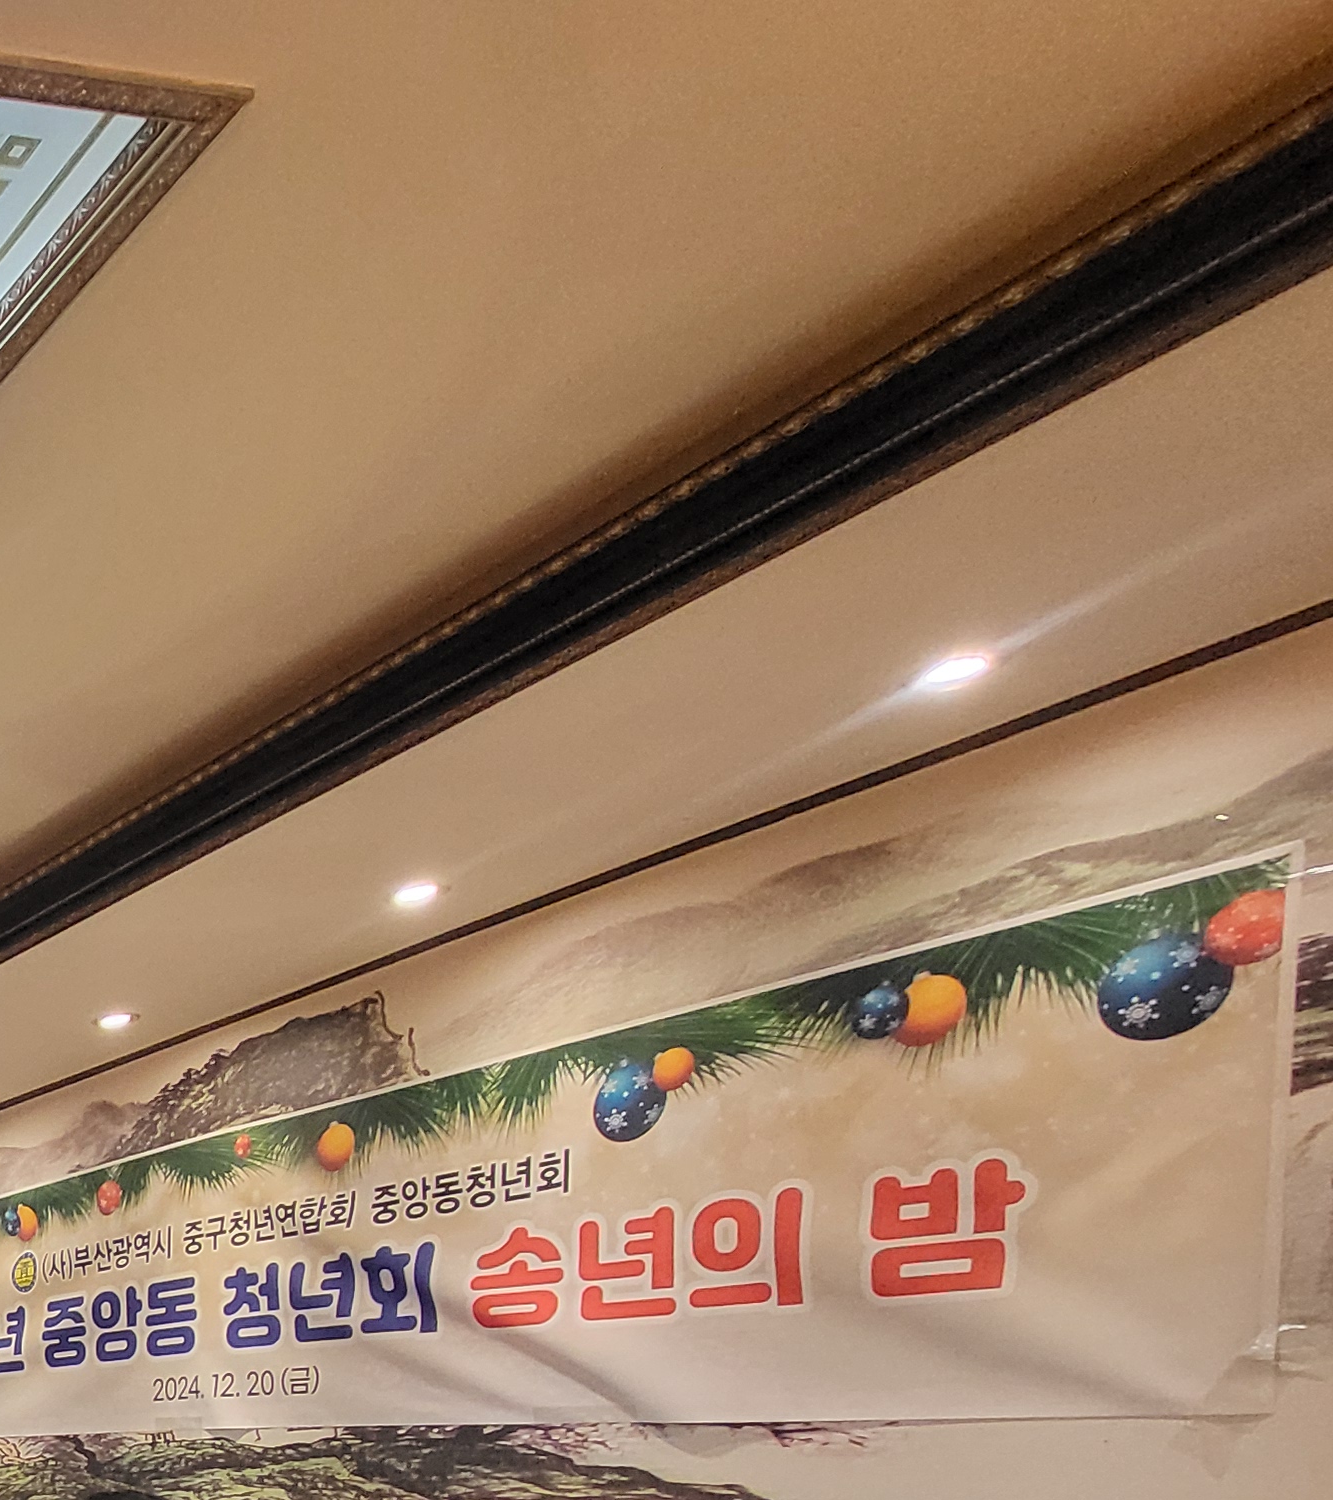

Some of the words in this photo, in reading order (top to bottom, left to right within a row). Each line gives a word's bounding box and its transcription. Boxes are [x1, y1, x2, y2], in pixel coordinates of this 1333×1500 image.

[41, 1225, 174, 1284] (사)부산광역시
[183, 1190, 356, 1257] 중구청년연합회
[370, 1149, 571, 1225] 중앙동청년회
[41, 1276, 198, 1368] 중앙동
[223, 1240, 440, 1356] 청년회
[469, 1186, 805, 1329] 송년의
[869, 1157, 1028, 1298] 밤
[152, 1375, 206, 1402] 2024.
[212, 1372, 242, 1399] 12.
[247, 1370, 277, 1397] 20
[280, 1365, 321, 1397] (금)
